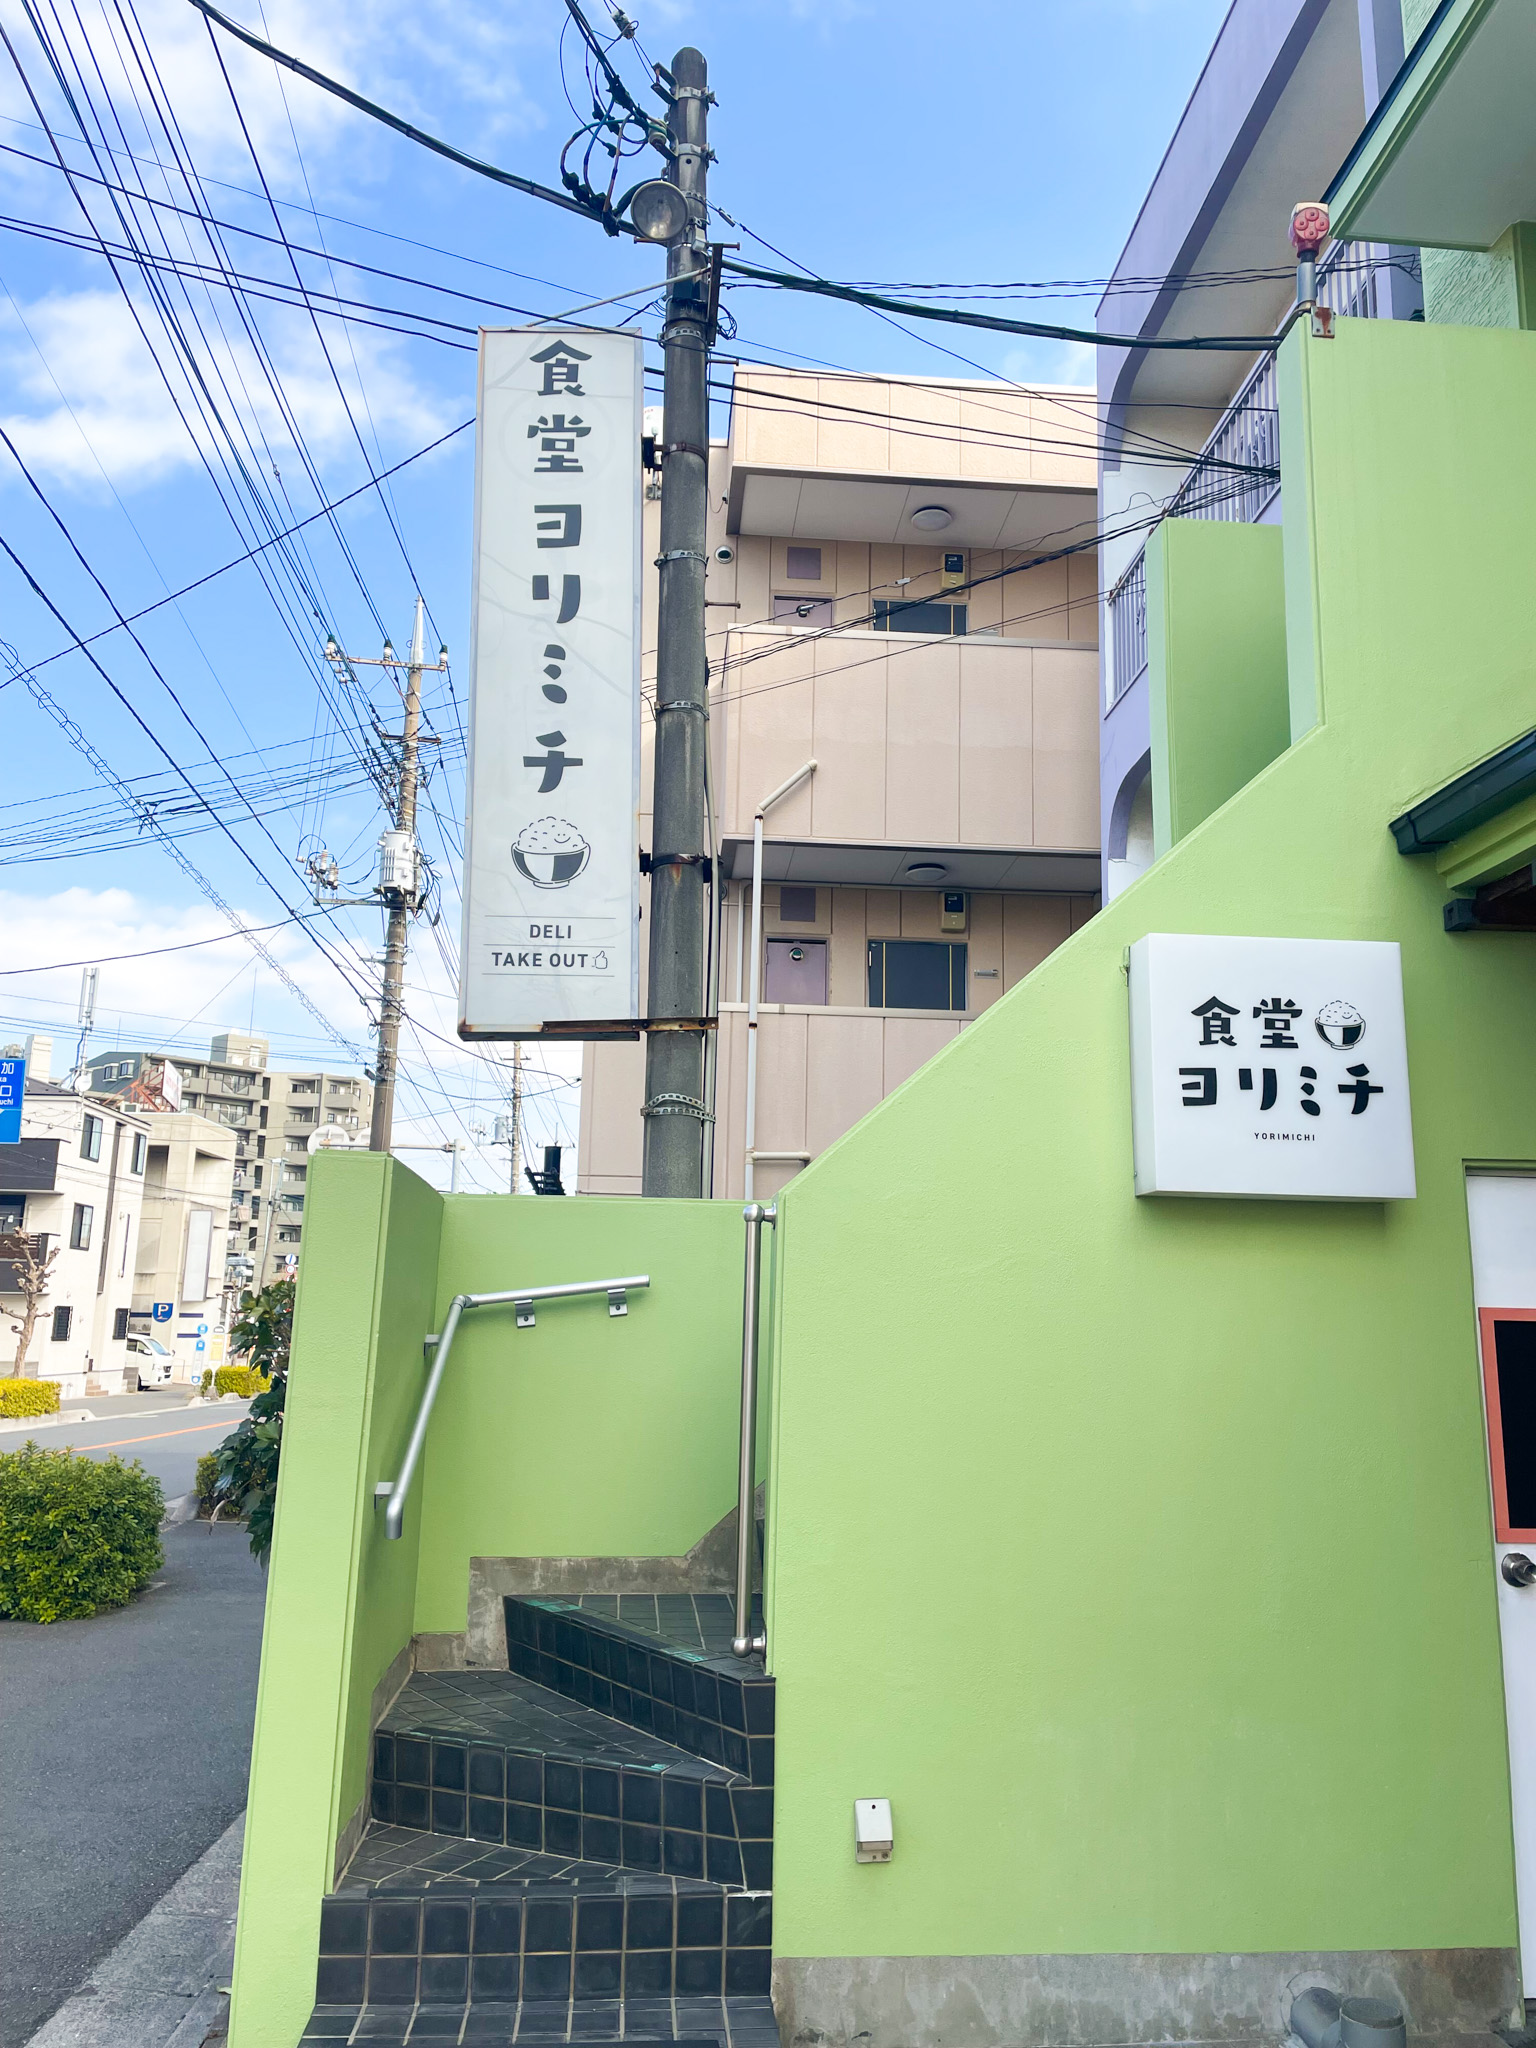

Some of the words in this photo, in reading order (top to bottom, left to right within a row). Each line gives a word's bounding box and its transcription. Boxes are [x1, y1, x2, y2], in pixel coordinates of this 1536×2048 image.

[522, 339, 593, 794] 食堂ヨリミチ
[529, 924, 572, 939] DELI
[491, 951, 543, 968] TAKE
[549, 952, 589, 968] OUT
[1190, 995, 1303, 1049] 食堂
[1178, 1062, 1384, 1117] ヨリミチ
[1254, 1132, 1316, 1142] YORIMICHI
[157, 1304, 170, 1316] P
